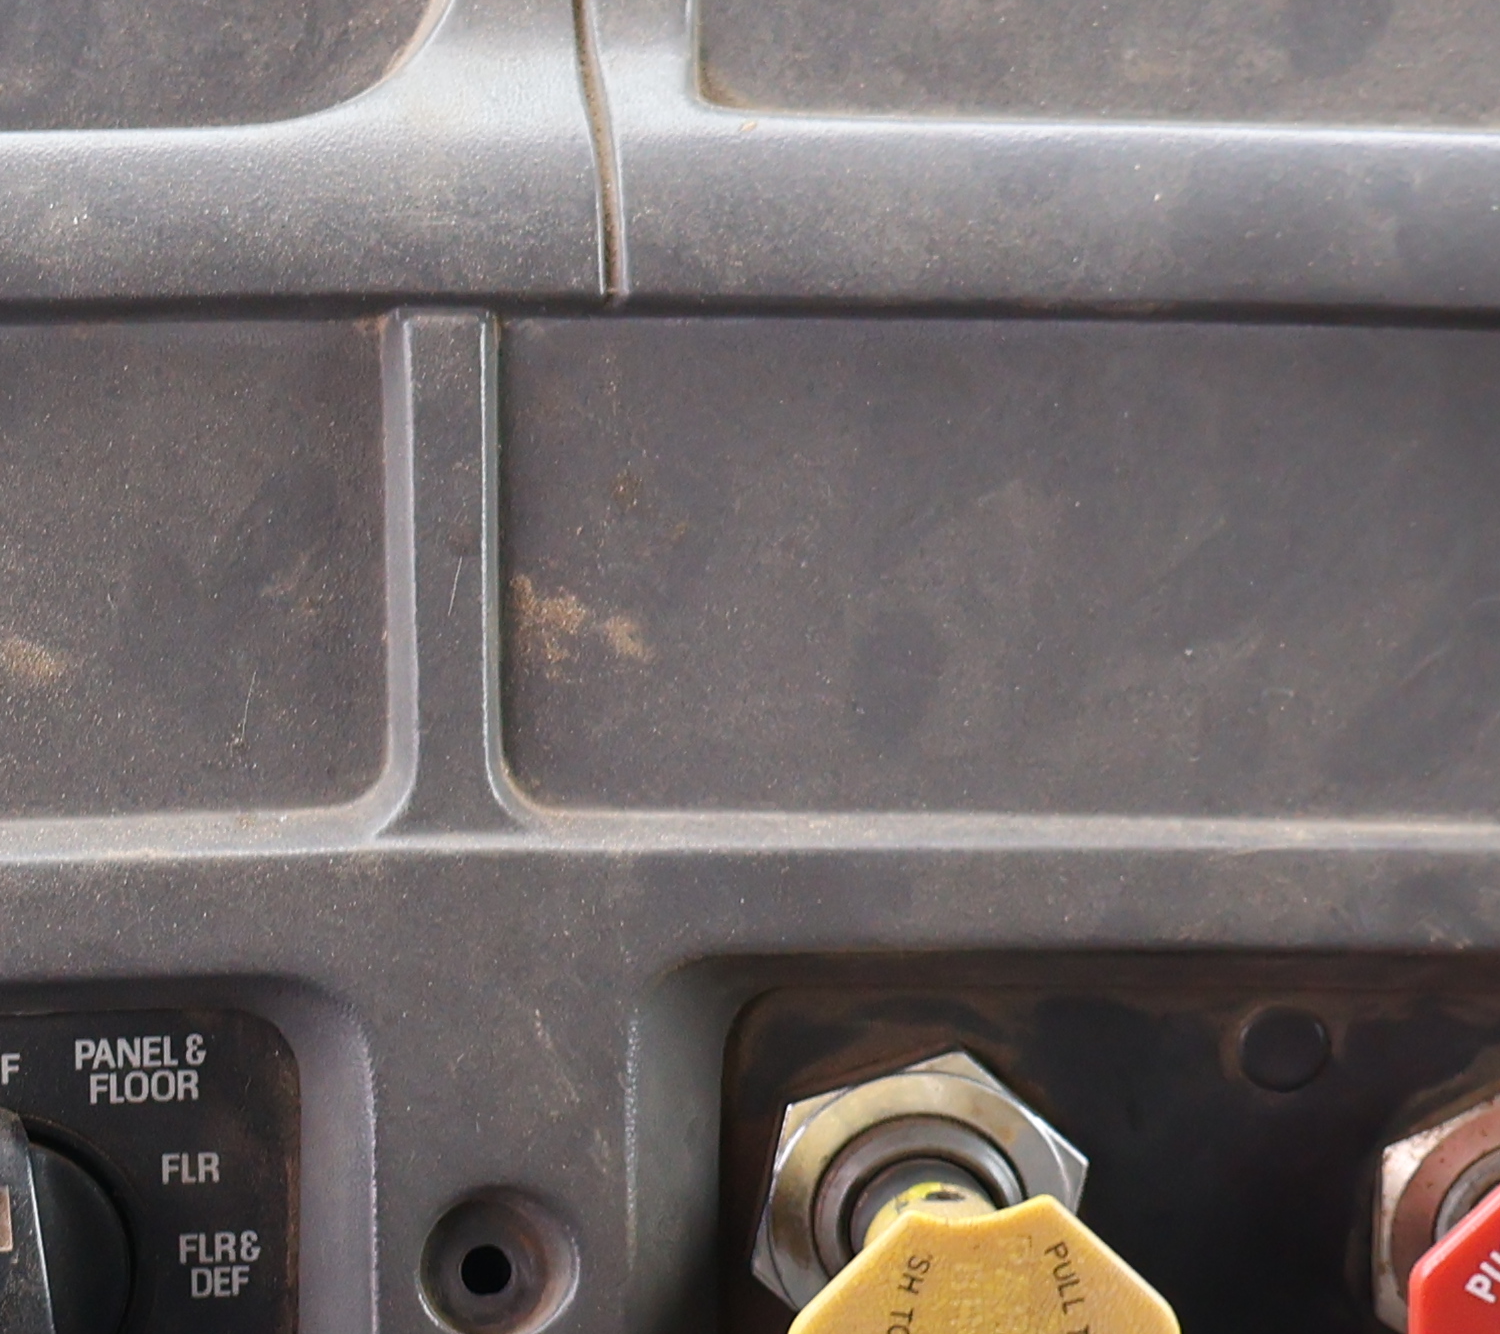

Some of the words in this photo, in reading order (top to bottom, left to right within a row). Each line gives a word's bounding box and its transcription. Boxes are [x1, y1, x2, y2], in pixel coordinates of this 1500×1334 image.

[74, 1036, 178, 1070] PANEL
[184, 1033, 207, 1066] &
[90, 1069, 199, 1104] FLOOR
[161, 1152, 220, 1185] FLR
[191, 1265, 250, 1298] DEF
[1044, 1240, 1085, 1315] PULL
